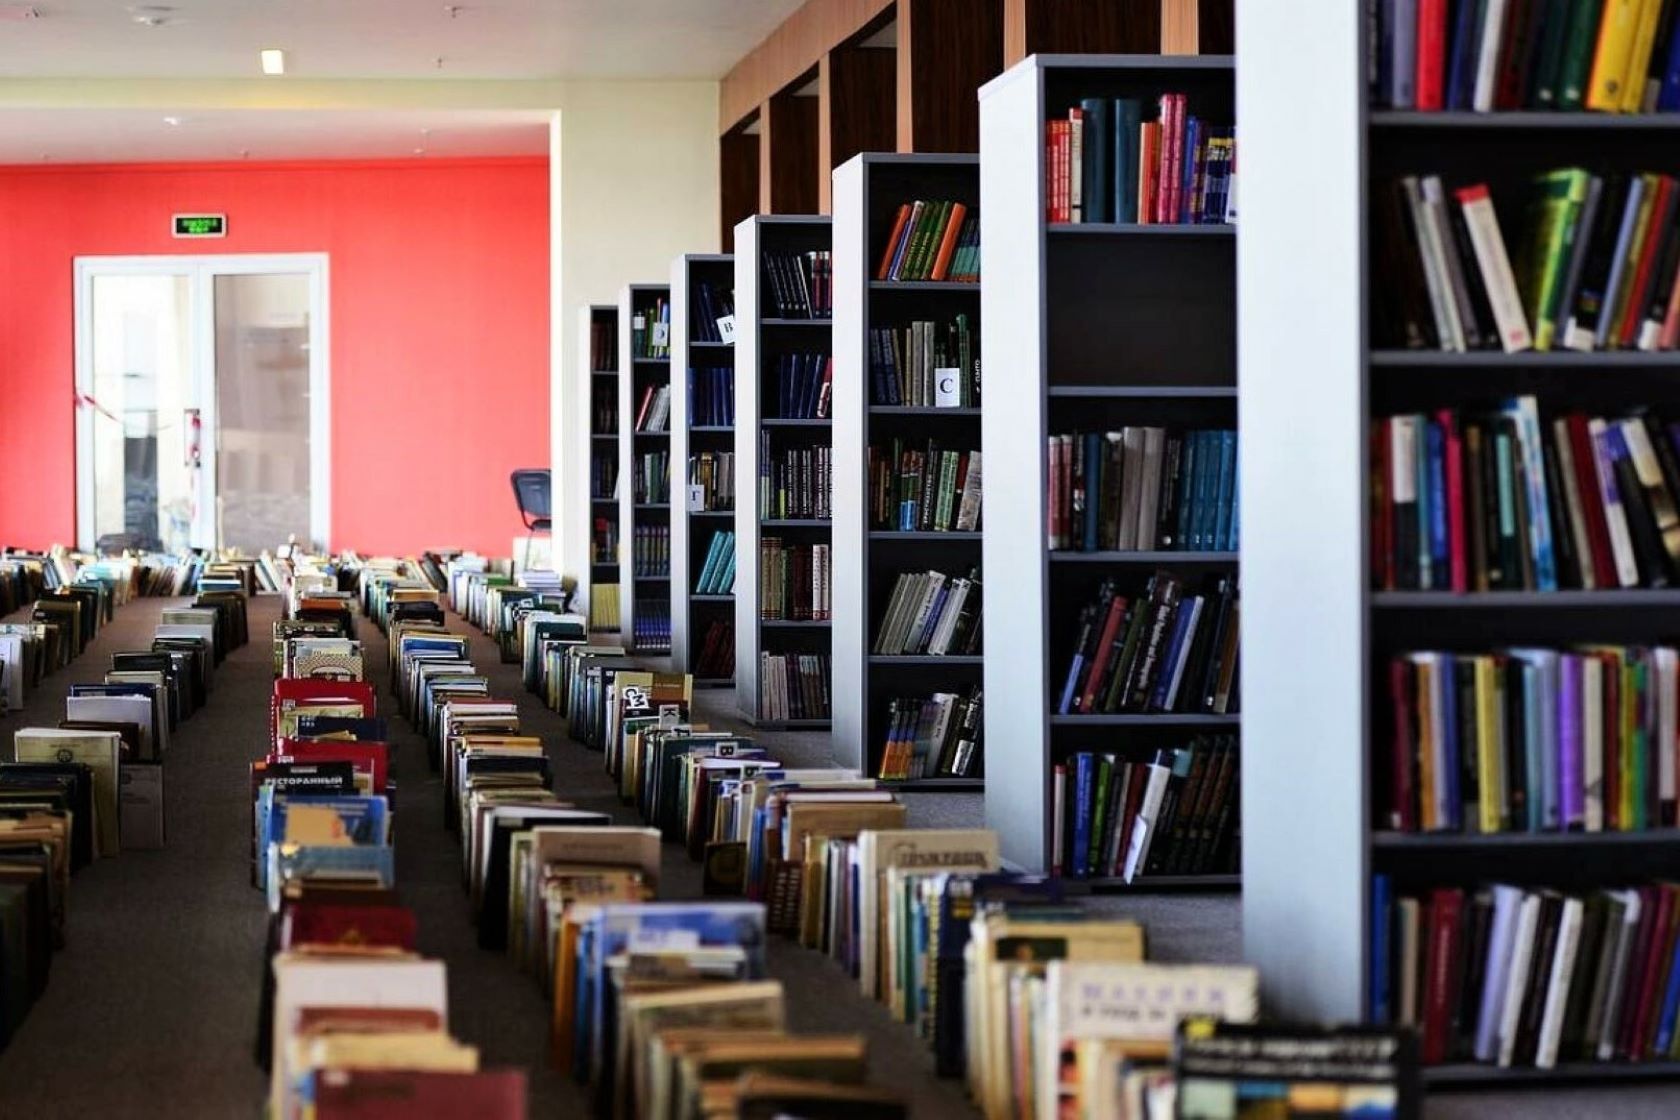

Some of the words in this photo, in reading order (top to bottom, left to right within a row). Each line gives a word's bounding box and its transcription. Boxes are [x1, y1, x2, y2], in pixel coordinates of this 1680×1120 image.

[940, 378, 953, 394] С
[632, 694, 646, 707] М
[664, 708, 676, 717] К
[720, 745, 734, 756] В
[264, 776, 343, 786] РЕСТОРАННЫЙ
